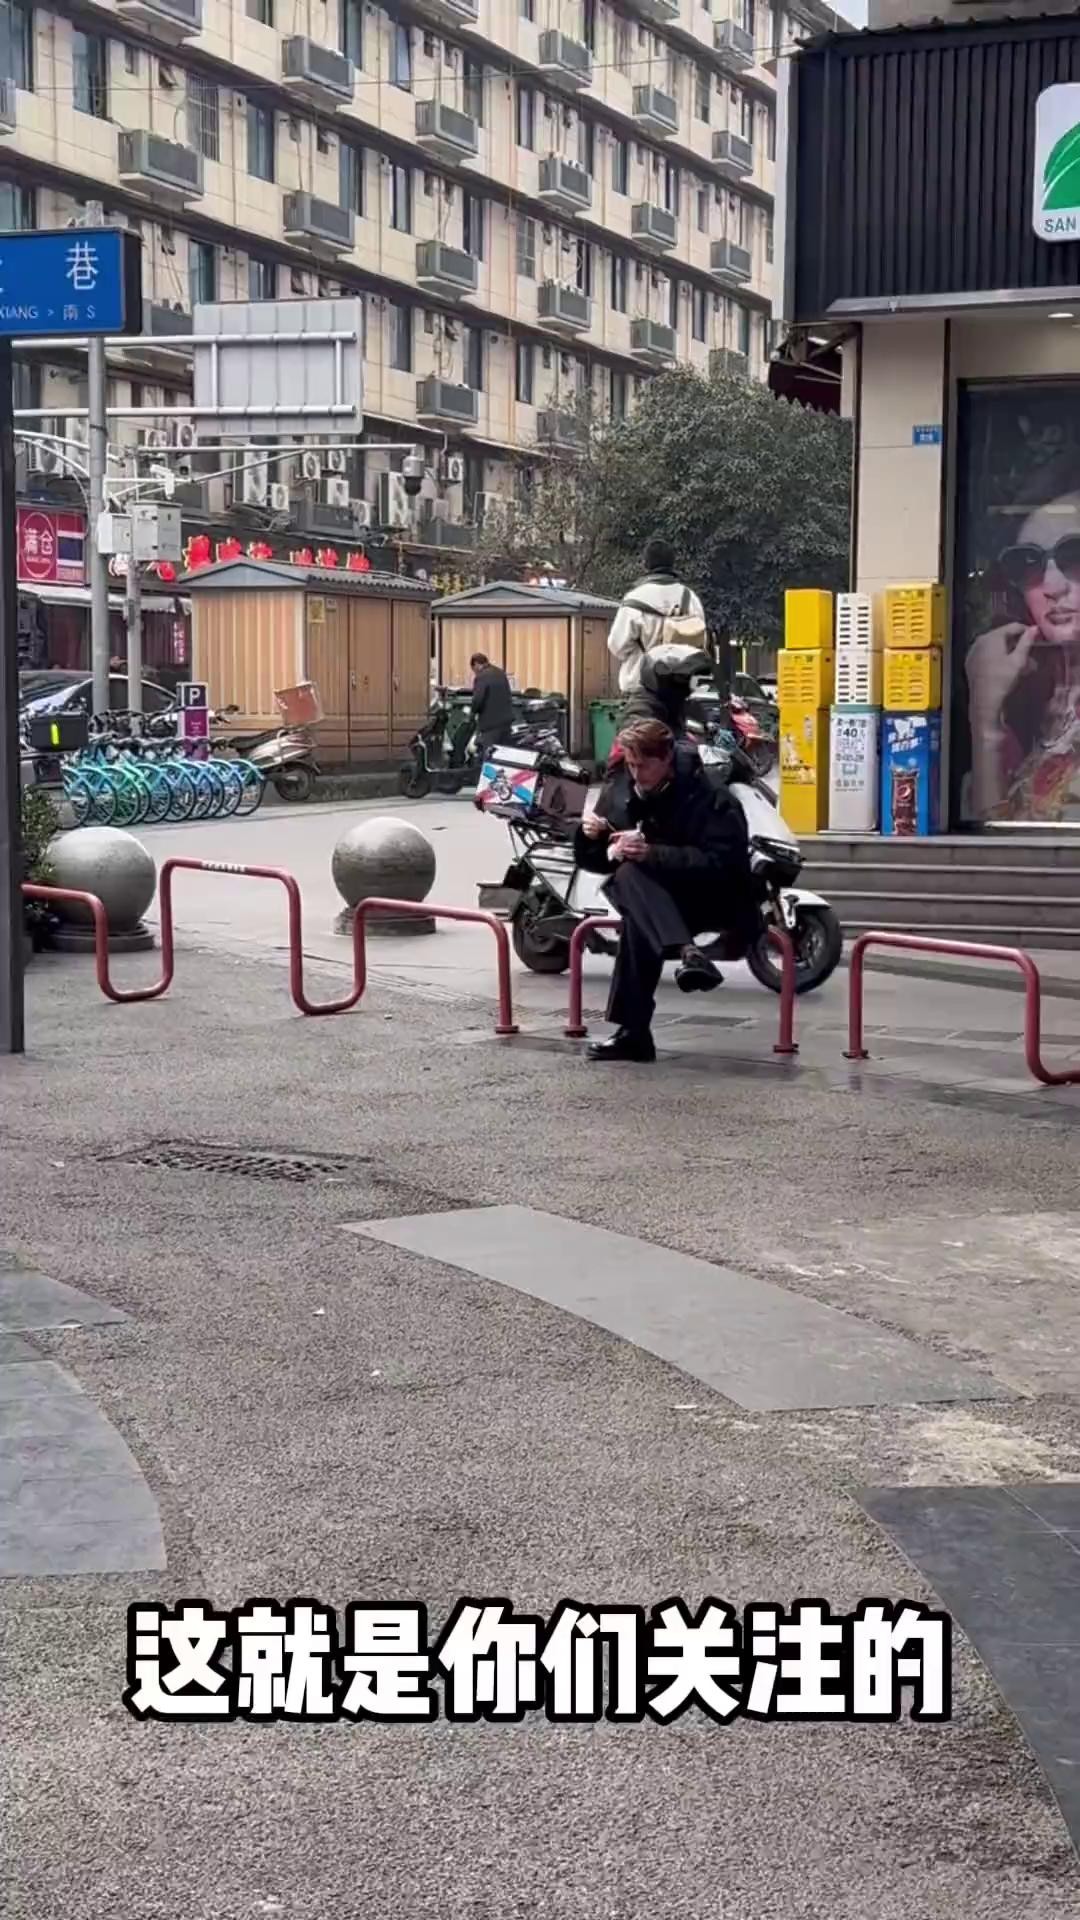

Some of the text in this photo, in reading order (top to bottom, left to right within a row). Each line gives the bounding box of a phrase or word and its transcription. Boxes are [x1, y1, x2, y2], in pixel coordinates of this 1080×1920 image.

[1044, 217, 1077, 233] SAN
[86, 305, 96, 320] S
[189, 688, 201, 705] P
